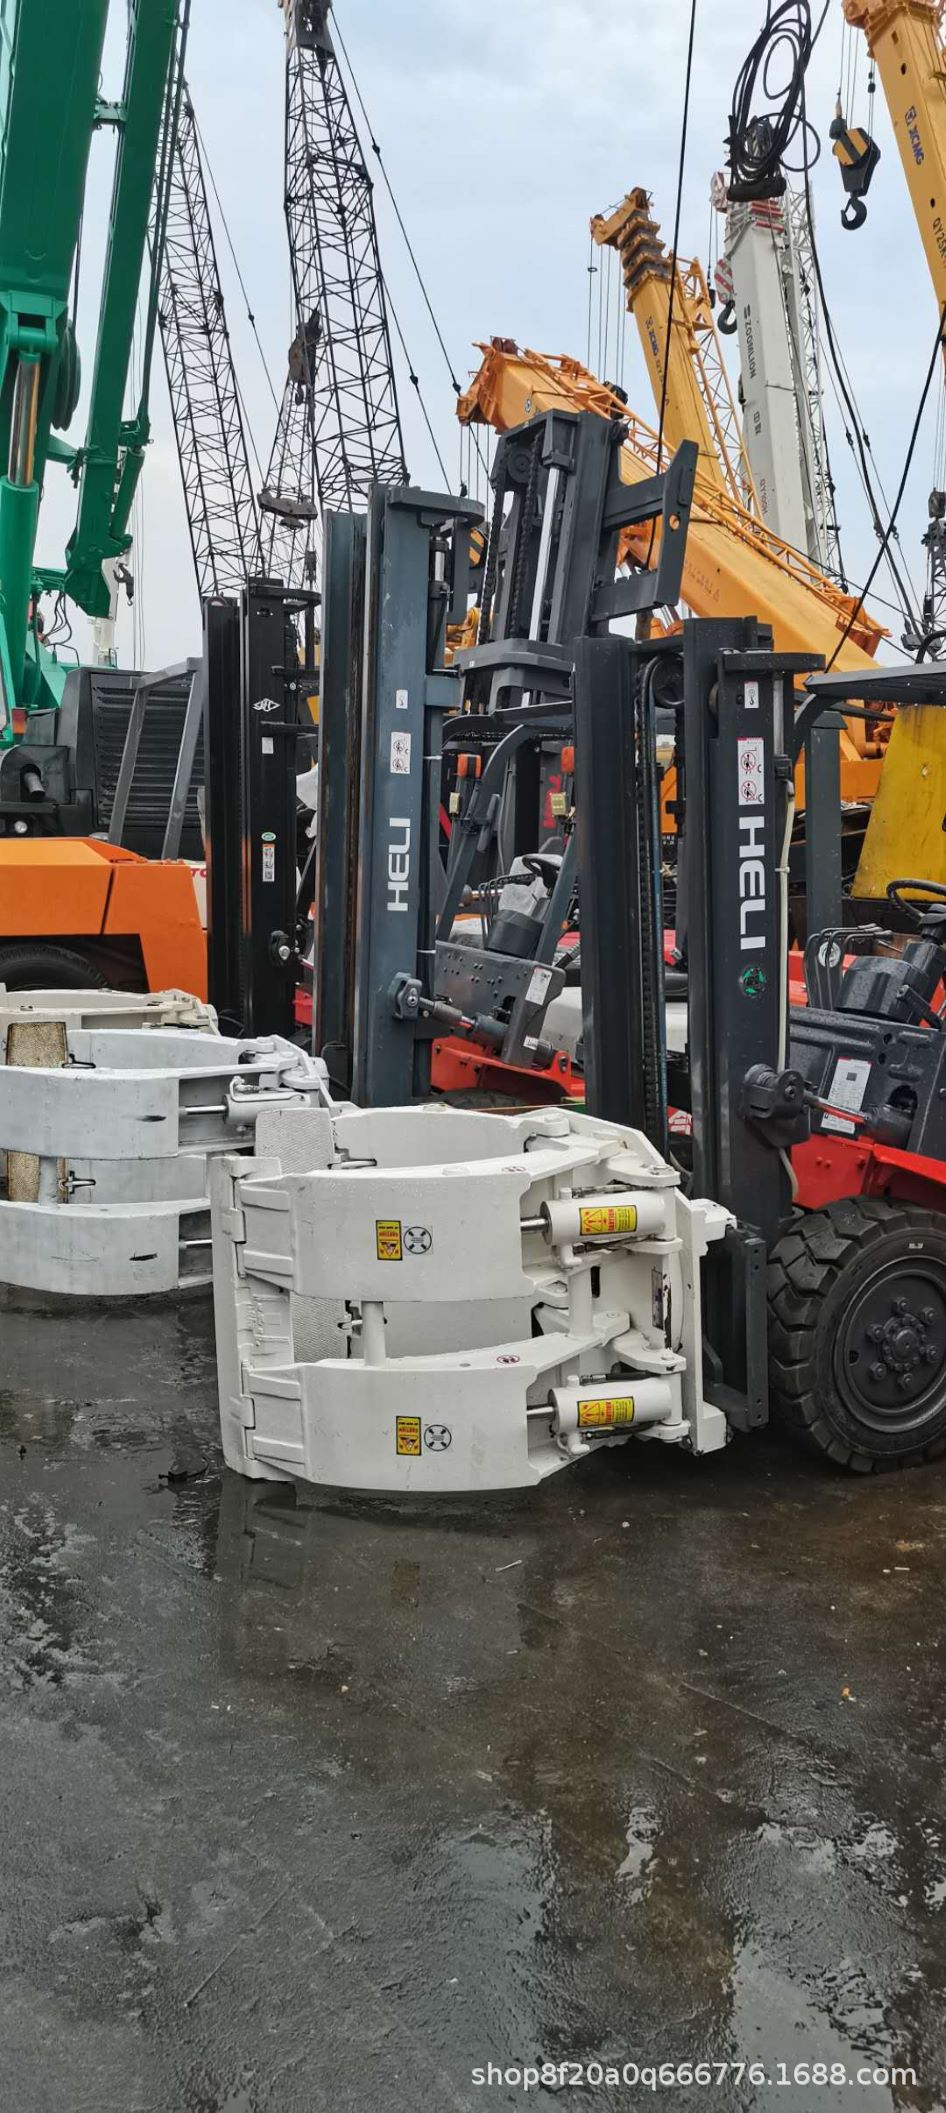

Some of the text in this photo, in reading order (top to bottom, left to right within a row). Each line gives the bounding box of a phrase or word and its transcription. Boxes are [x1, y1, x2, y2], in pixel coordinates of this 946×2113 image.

[908, 124, 925, 166] XCMG
[744, 319, 757, 380] ZOOMLION
[387, 818, 411, 911] HELI
[739, 816, 766, 950] HELI
